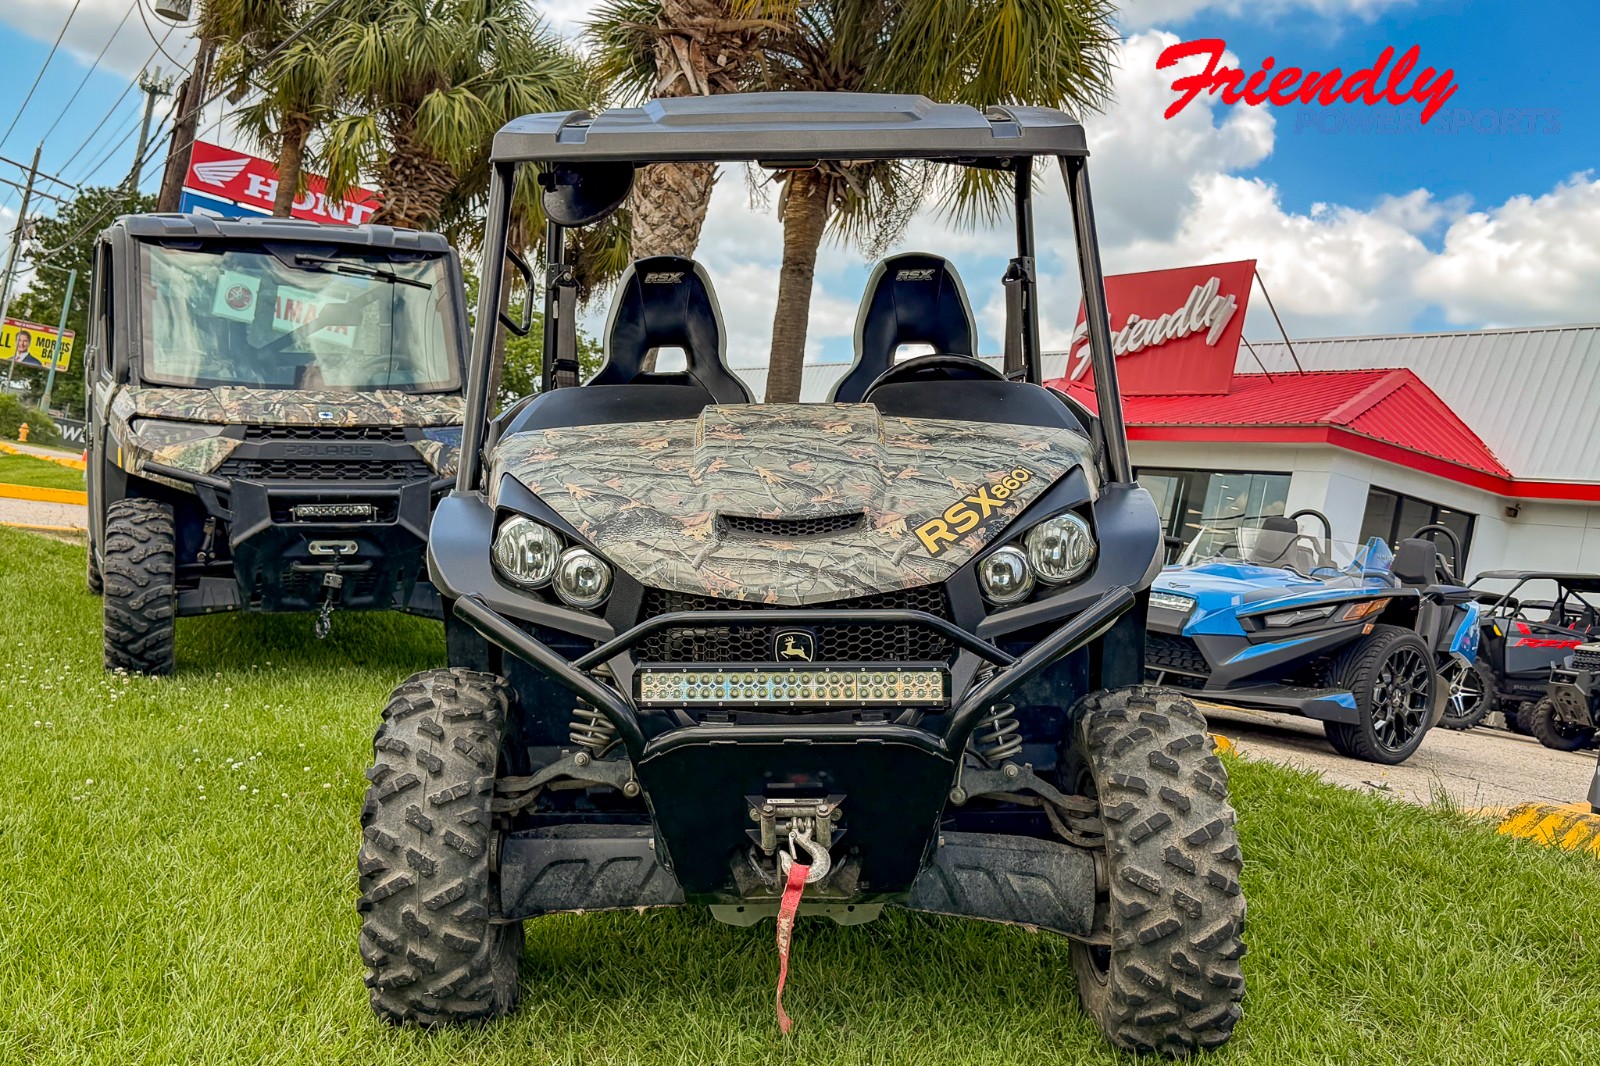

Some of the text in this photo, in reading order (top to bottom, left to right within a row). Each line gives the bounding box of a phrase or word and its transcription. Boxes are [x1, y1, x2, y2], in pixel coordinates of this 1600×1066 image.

[645, 272, 684, 283] RSX
[896, 269, 935, 281] RSX
[36, 337, 70, 353] MORIS
[41, 349, 64, 361] BAT
[284, 445, 373, 457] POLARIS
[915, 465, 1034, 554] RSX 860i
